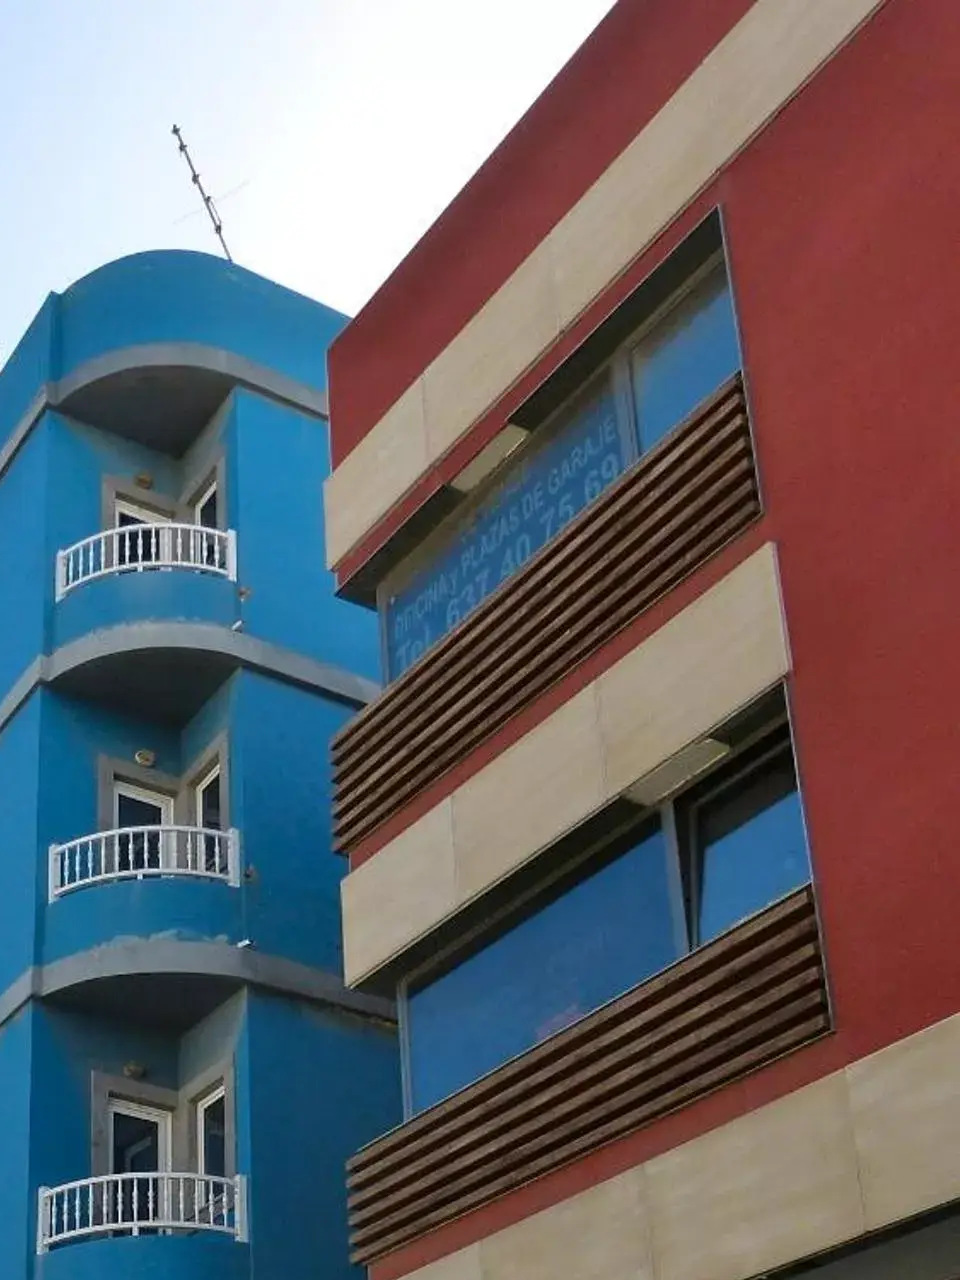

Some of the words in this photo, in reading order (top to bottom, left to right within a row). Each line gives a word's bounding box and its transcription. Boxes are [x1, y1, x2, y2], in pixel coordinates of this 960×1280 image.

[461, 504, 520, 578] PLAZAS
[522, 482, 544, 521] DE
[548, 414, 617, 496] GARAJE
[584, 452, 620, 504] 69
